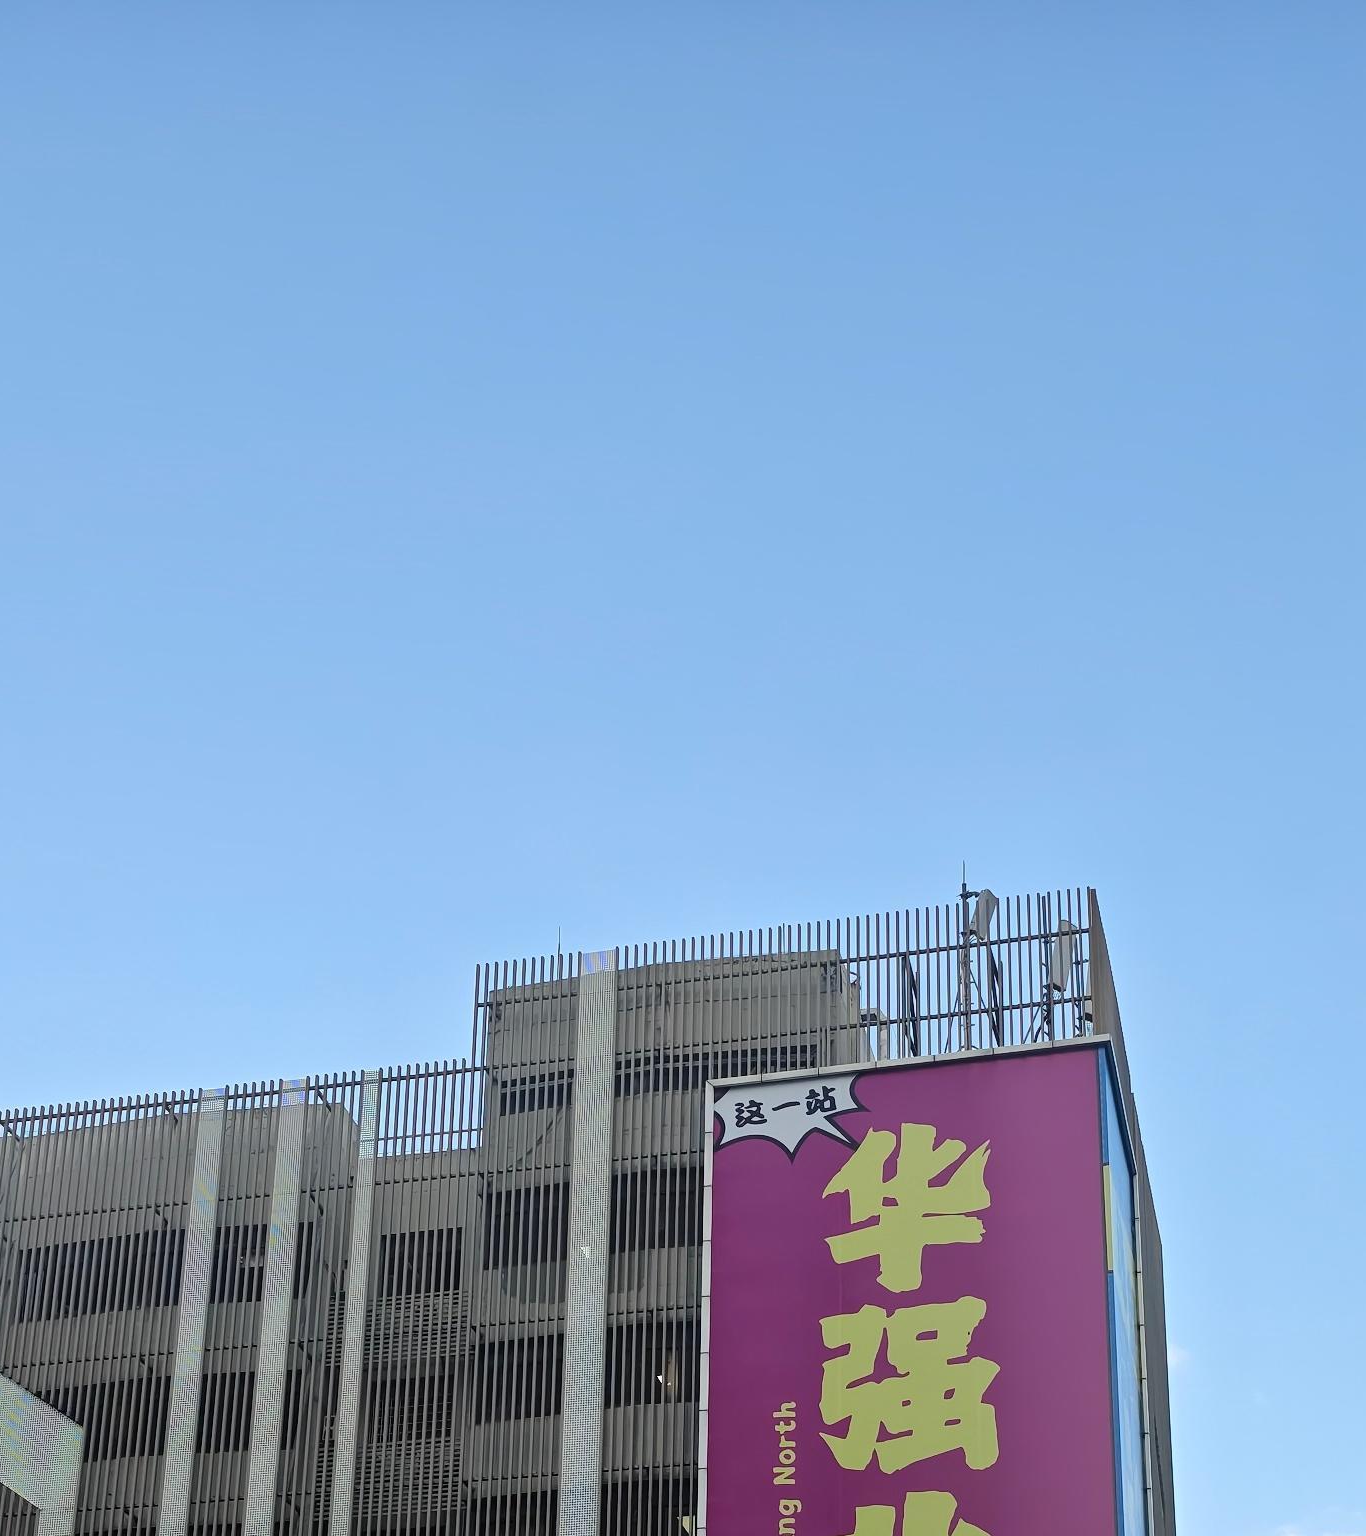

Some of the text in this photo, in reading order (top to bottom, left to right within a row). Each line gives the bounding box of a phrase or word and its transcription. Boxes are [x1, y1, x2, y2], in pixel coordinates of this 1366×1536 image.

[735, 1086, 837, 1128] 这一站
[773, 1401, 797, 1485] North
